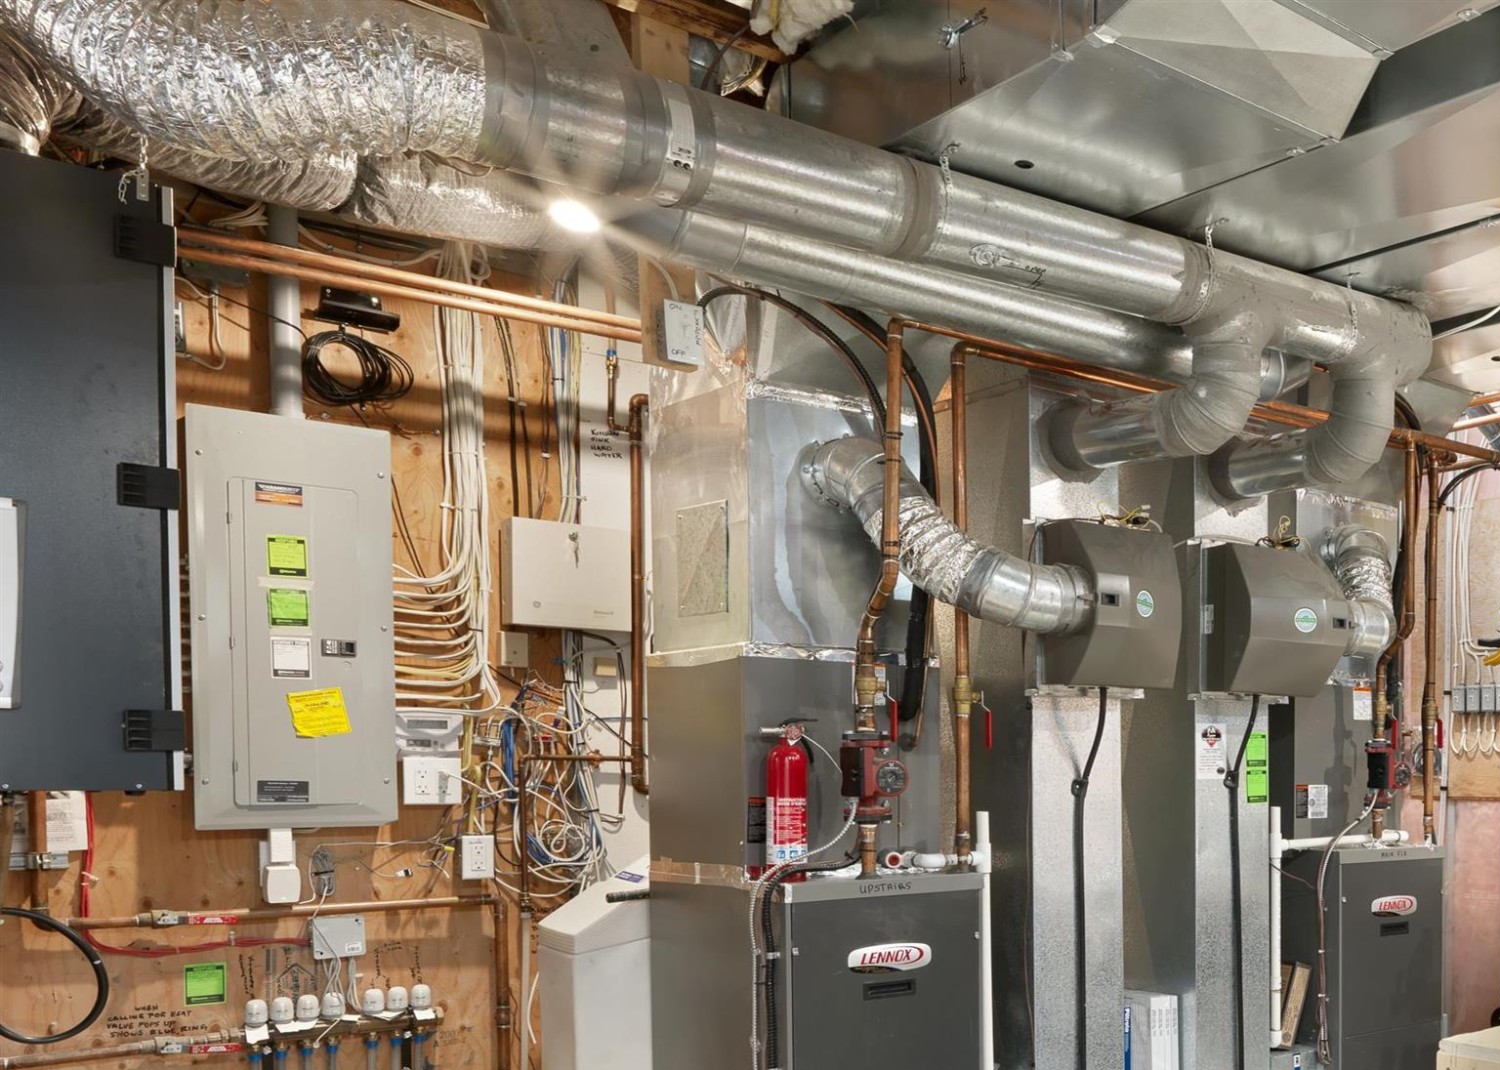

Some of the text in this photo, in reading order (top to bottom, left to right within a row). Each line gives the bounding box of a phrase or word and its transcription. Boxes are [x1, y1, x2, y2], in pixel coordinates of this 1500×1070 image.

[668, 303, 683, 311] ON
[671, 348, 687, 357] OFF
[590, 444, 613, 452] HARD
[859, 881, 912, 894] UPSTAIRS
[1378, 899, 1407, 911] LENNOX
[860, 948, 912, 965] LENNOX
[134, 1004, 159, 1012] WHEN
[107, 1010, 192, 1022] CALLING FOR HEAT
[106, 1020, 177, 1030] VALVE POPS UP
[110, 1030, 144, 1038] SHOWS
[149, 1027, 177, 1036] BLUE
